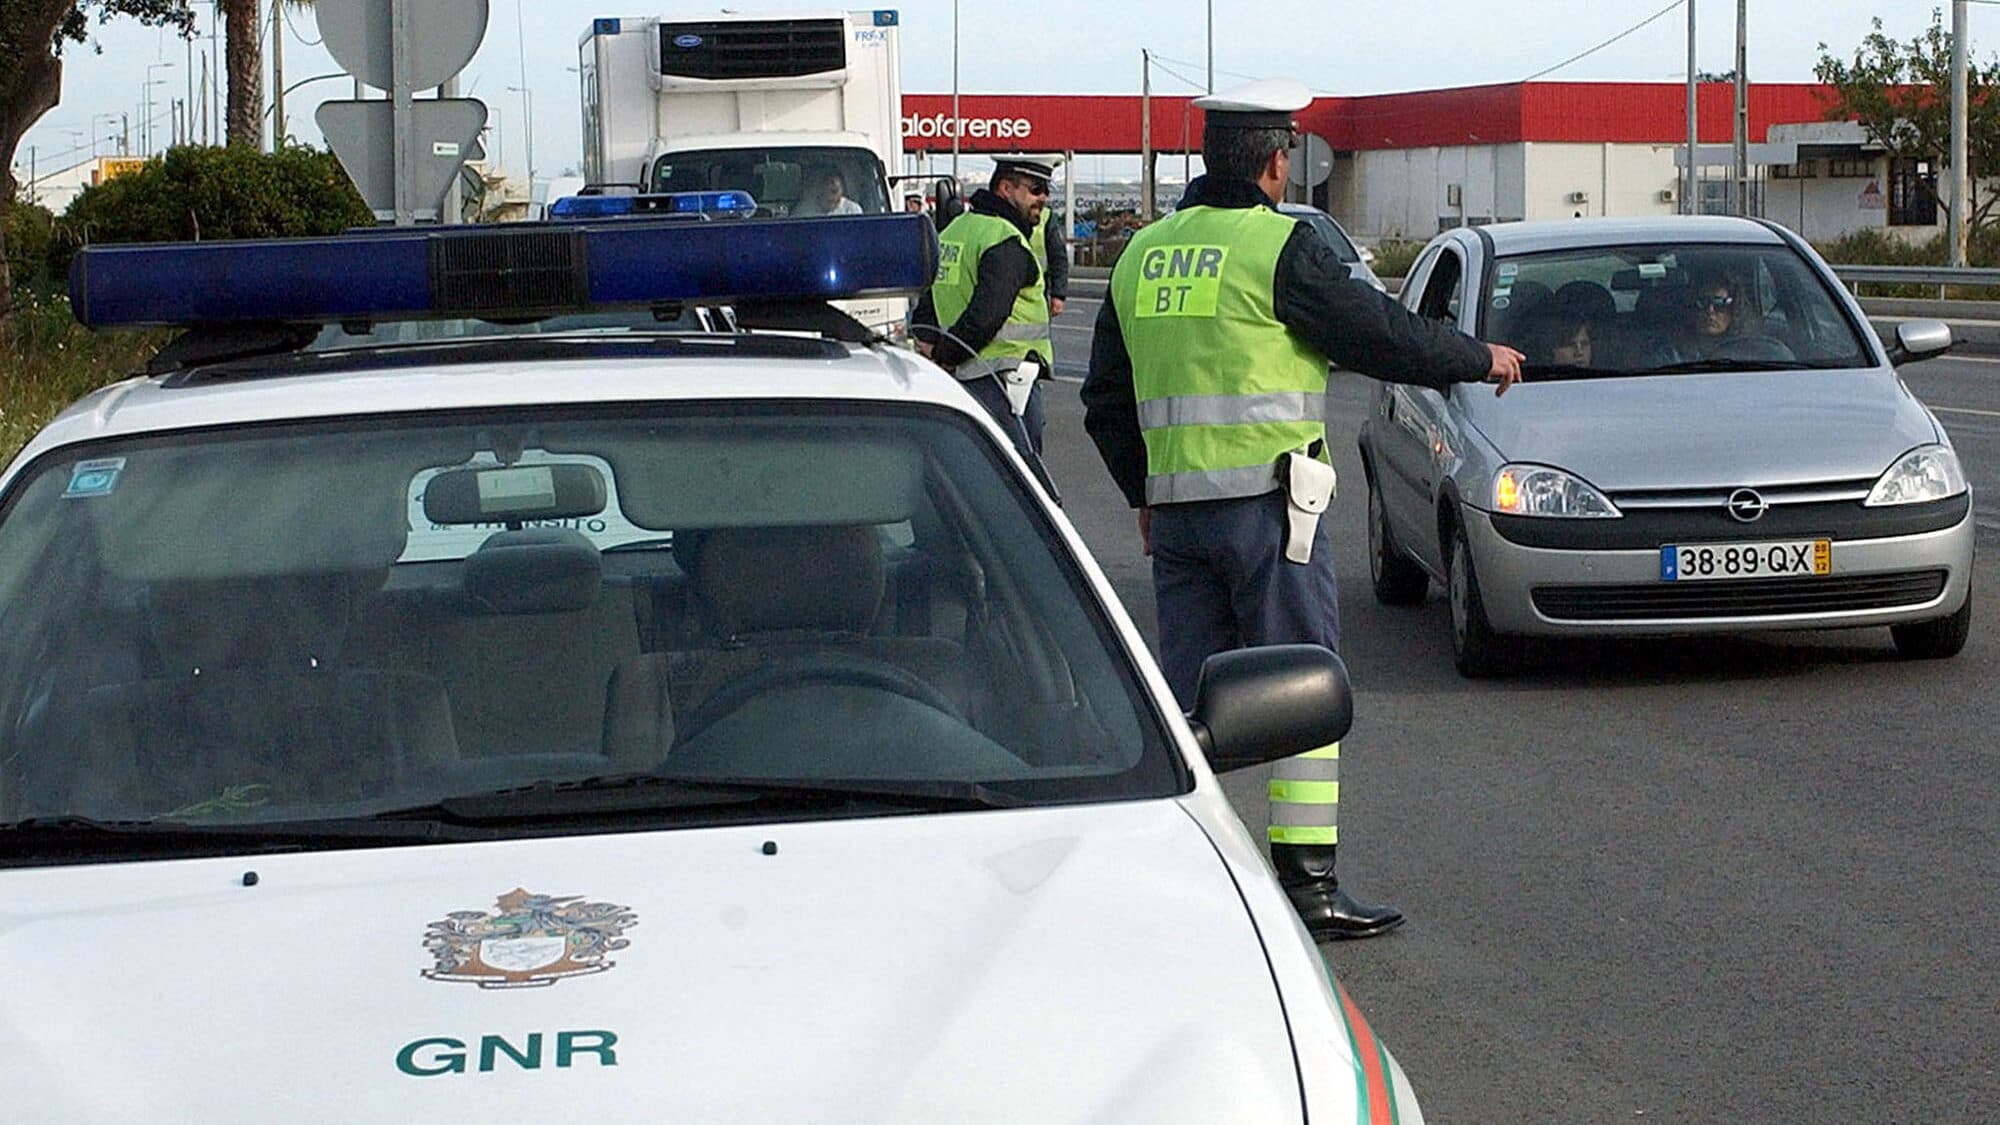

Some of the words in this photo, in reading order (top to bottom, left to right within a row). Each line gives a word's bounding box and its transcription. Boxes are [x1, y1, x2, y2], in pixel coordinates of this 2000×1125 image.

[1142, 247, 1223, 280] GNR
[1155, 285, 1193, 313] BT
[396, 1030, 618, 1076] GNR
